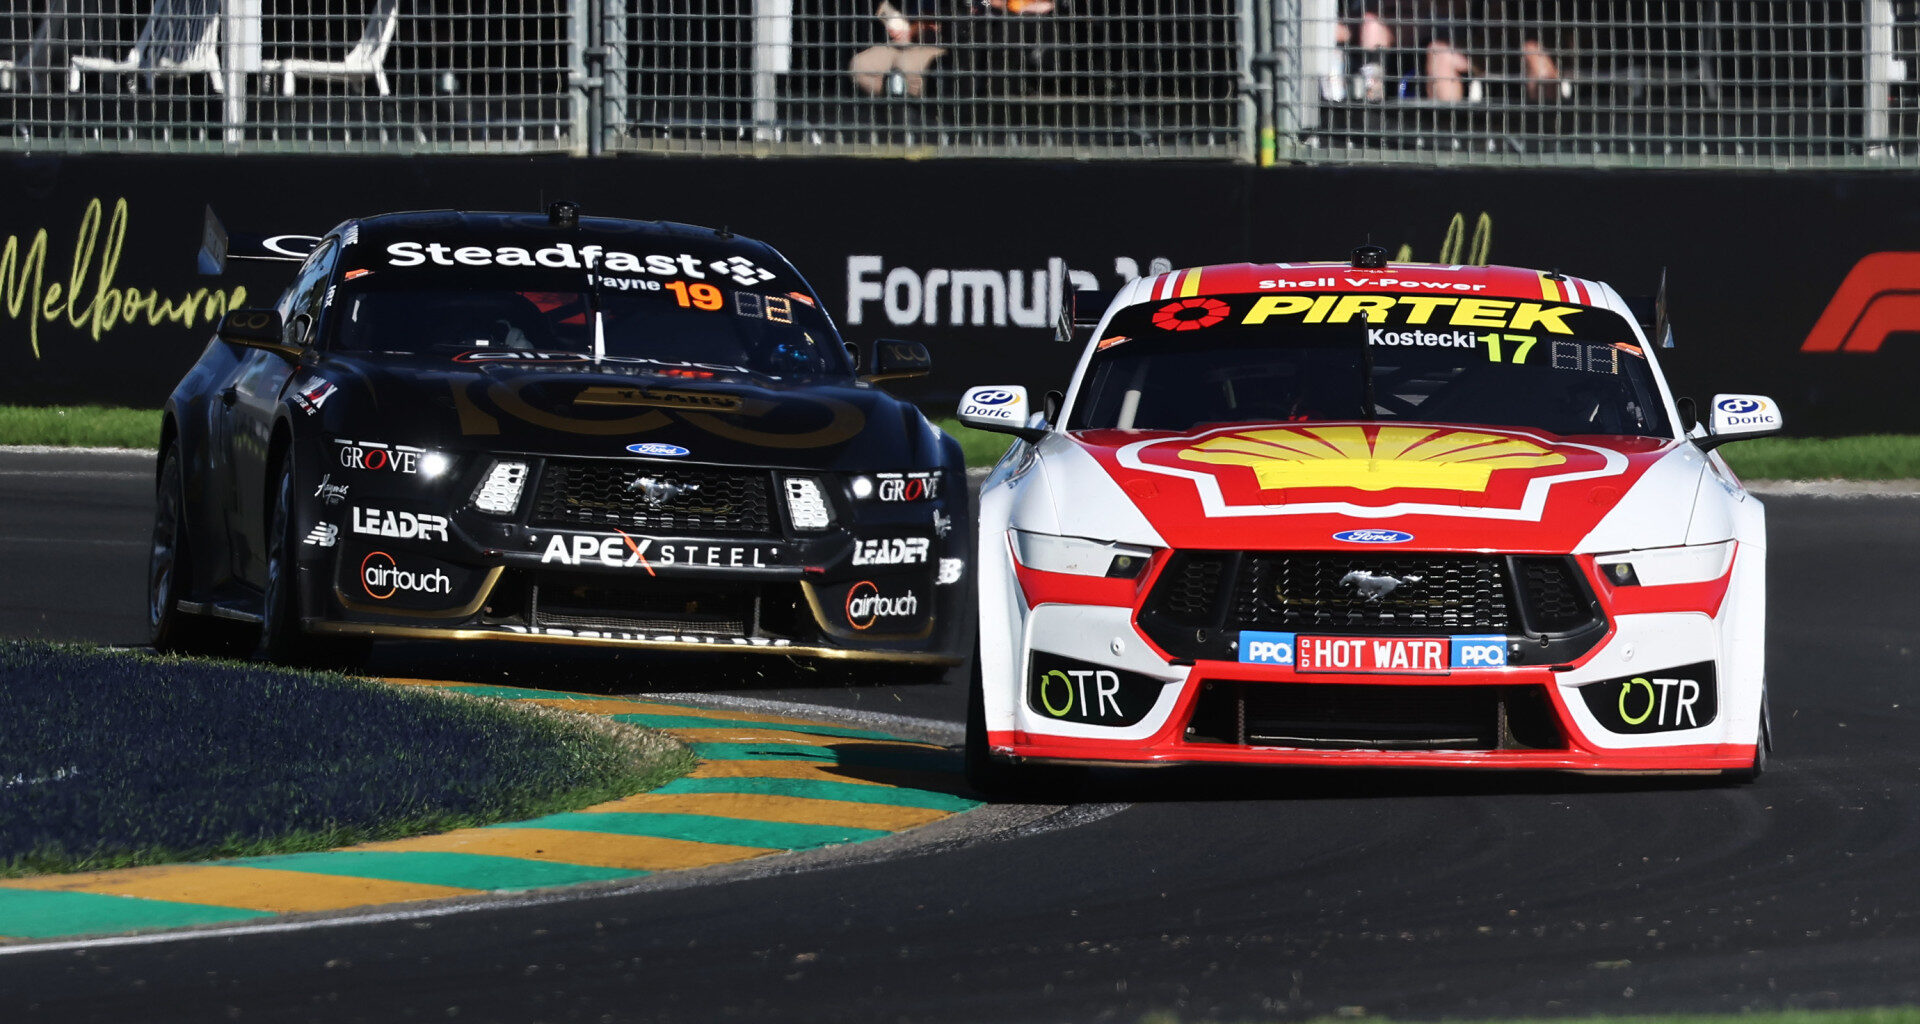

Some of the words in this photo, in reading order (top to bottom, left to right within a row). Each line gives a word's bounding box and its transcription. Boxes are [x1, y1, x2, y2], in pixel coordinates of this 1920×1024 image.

[387, 241, 706, 279] Steadfast
[665, 280, 723, 311] 19
[1258, 277, 1336, 289] Shell
[1345, 278, 1487, 291] V-Power
[1241, 295, 1583, 335] PIRTEK
[1368, 328, 1476, 350] Kostecki
[1477, 333, 1537, 365] 17
[964, 405, 1012, 418] Doric
[1727, 413, 1775, 426] Doric
[340, 446, 417, 474] GROVE
[353, 506, 449, 542] LEADER
[541, 528, 657, 577] APEX
[659, 544, 766, 569] STEEL
[852, 537, 930, 566] LEADER
[365, 563, 451, 594] airtouch
[850, 589, 917, 618] airtouch
[1249, 641, 1294, 664] PPQ
[1314, 640, 1367, 668] HOT
[1373, 641, 1443, 670] WATR
[1461, 644, 1505, 665] PPQ
[1041, 669, 1124, 717] OTR
[1618, 677, 1700, 727] OTR
